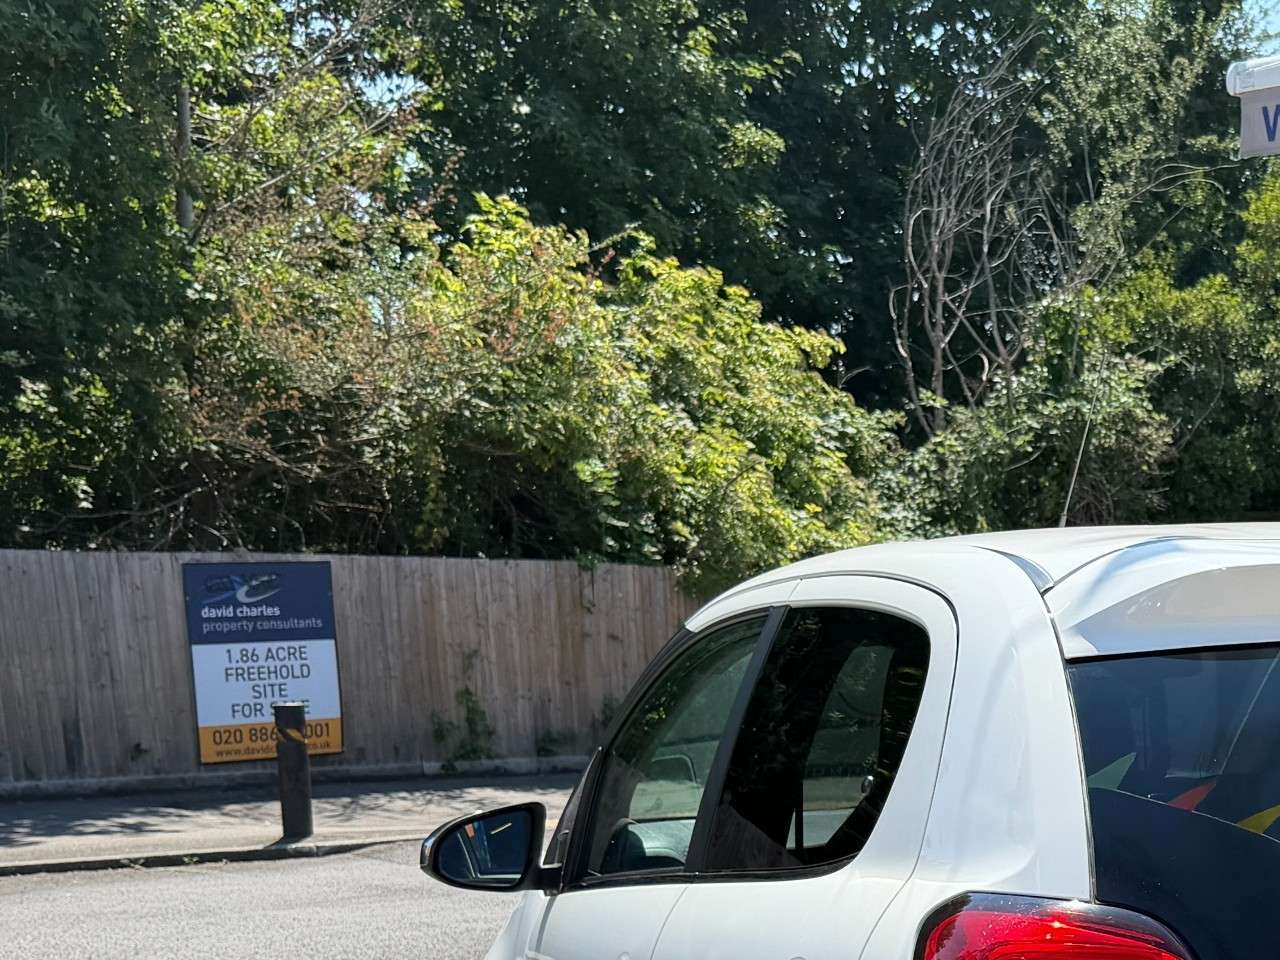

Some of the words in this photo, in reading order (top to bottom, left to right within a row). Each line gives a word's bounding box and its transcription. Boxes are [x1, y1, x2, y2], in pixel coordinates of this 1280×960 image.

[201, 605, 234, 618] david
[236, 604, 281, 617] charles
[203, 620, 254, 634] property
[257, 617, 323, 630] consultants
[226, 648, 260, 664] 1.86
[265, 646, 309, 663] ACRE
[224, 664, 311, 682] FREEHOLD
[251, 683, 289, 699] SITE
[231, 702, 265, 719] FOR
[212, 728, 244, 745] 020
